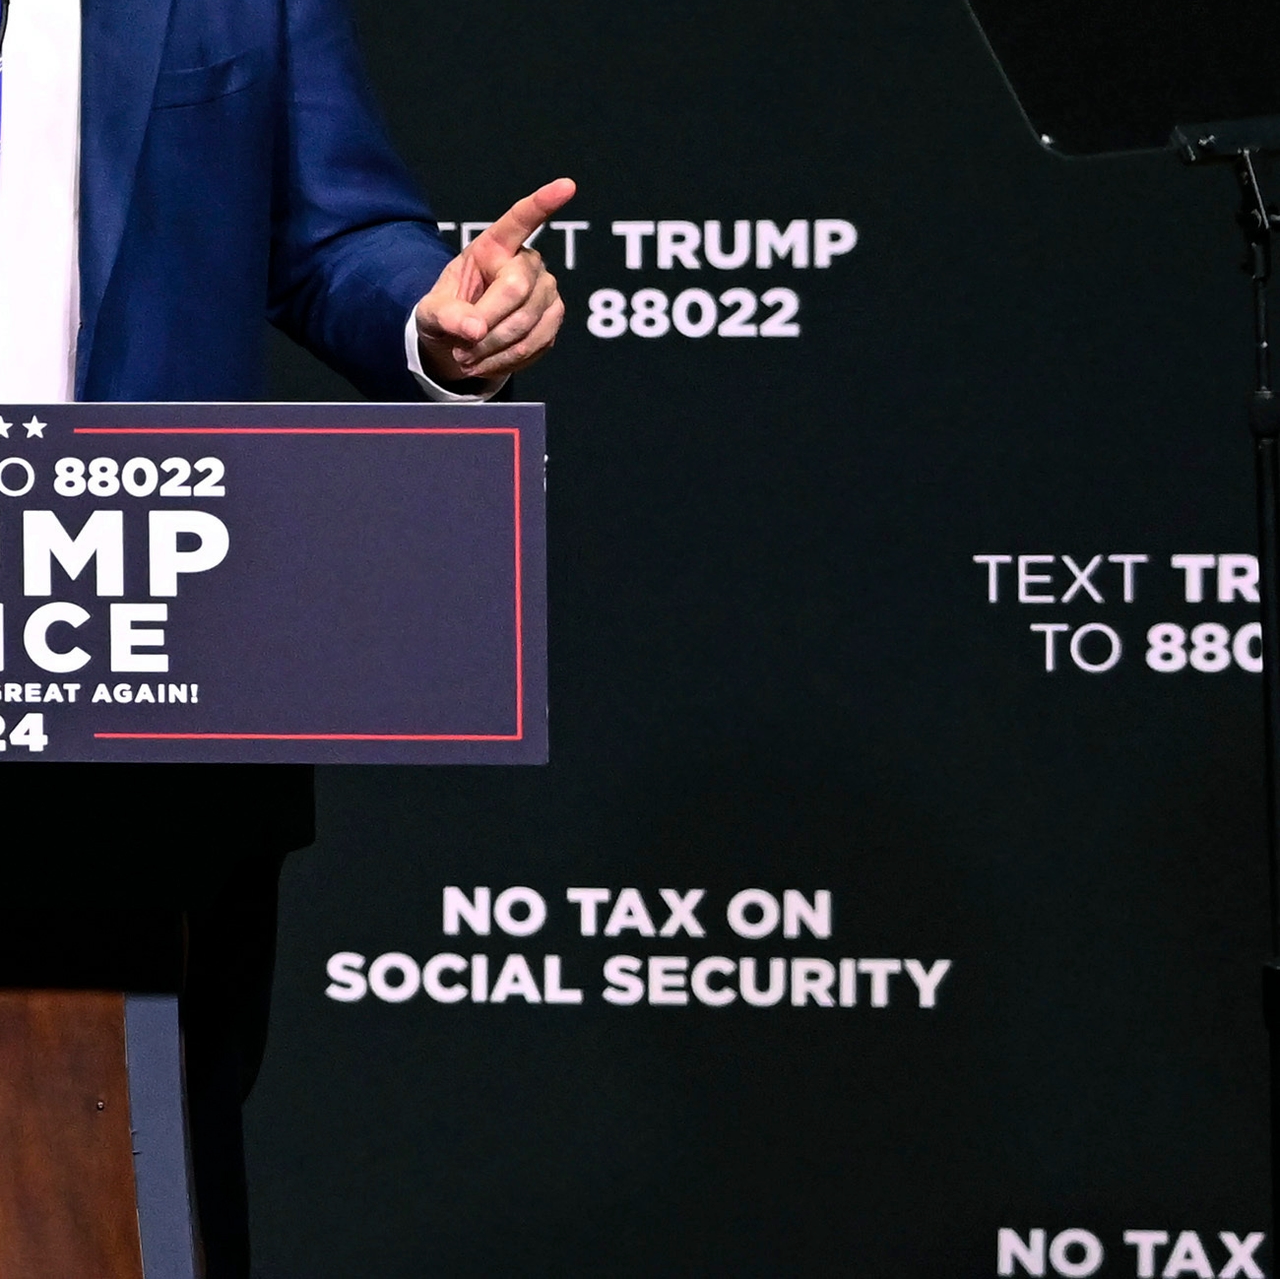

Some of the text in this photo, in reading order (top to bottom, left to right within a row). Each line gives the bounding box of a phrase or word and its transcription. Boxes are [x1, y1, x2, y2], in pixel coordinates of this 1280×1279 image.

[610, 217, 859, 271] TRUMP
[585, 286, 802, 340] 88022
[52, 455, 227, 499] 88022
[971, 552, 1150, 605] TEXT
[1028, 621, 1123, 674] TO
[90, 681, 200, 705] AGAIN!
[441, 885, 833, 941] NO TAX ON
[324, 950, 952, 1009] SOCIAL SECURITY
[996, 1226, 1266, 1279] NO TAX
